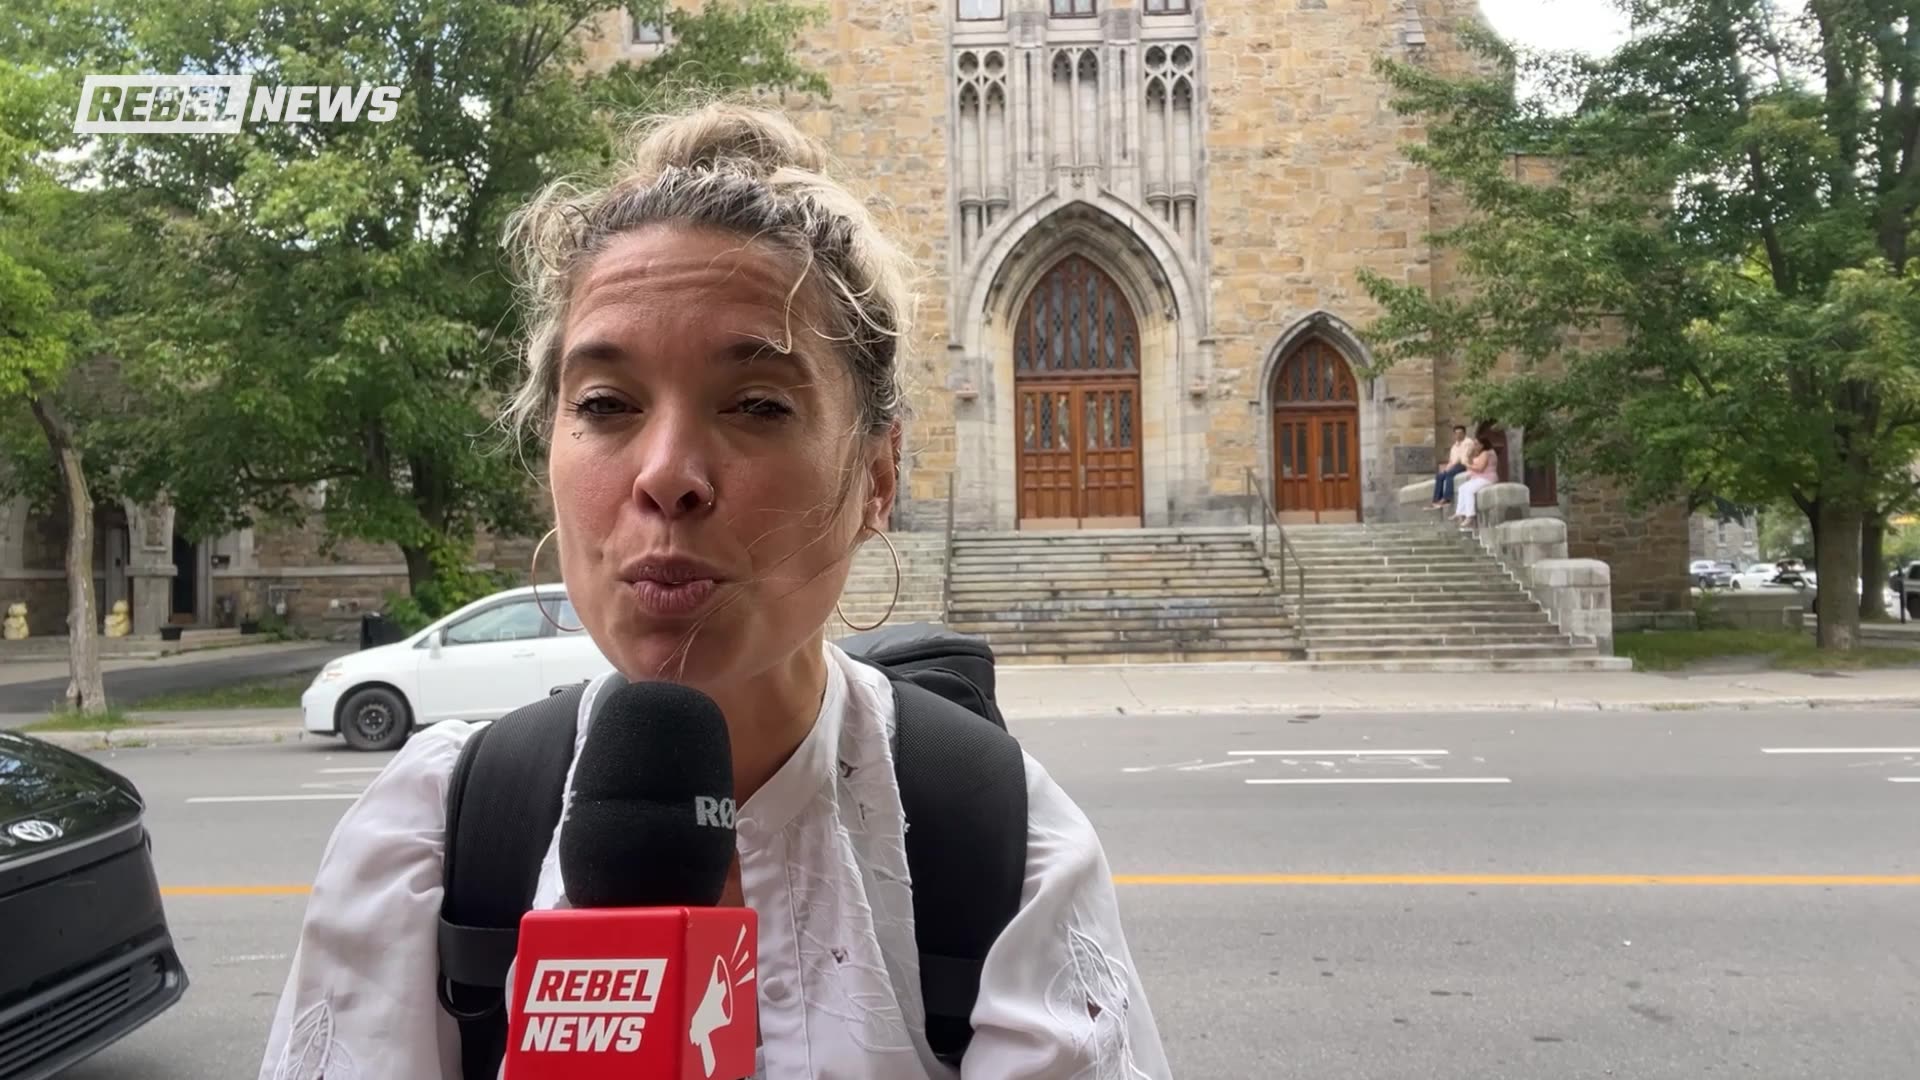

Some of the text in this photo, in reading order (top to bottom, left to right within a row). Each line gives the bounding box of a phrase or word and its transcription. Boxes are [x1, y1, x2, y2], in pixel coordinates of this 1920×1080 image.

[695, 795, 736, 830] RØ
[535, 968, 654, 1003] REBEL
[520, 1016, 647, 1053] NEWS
